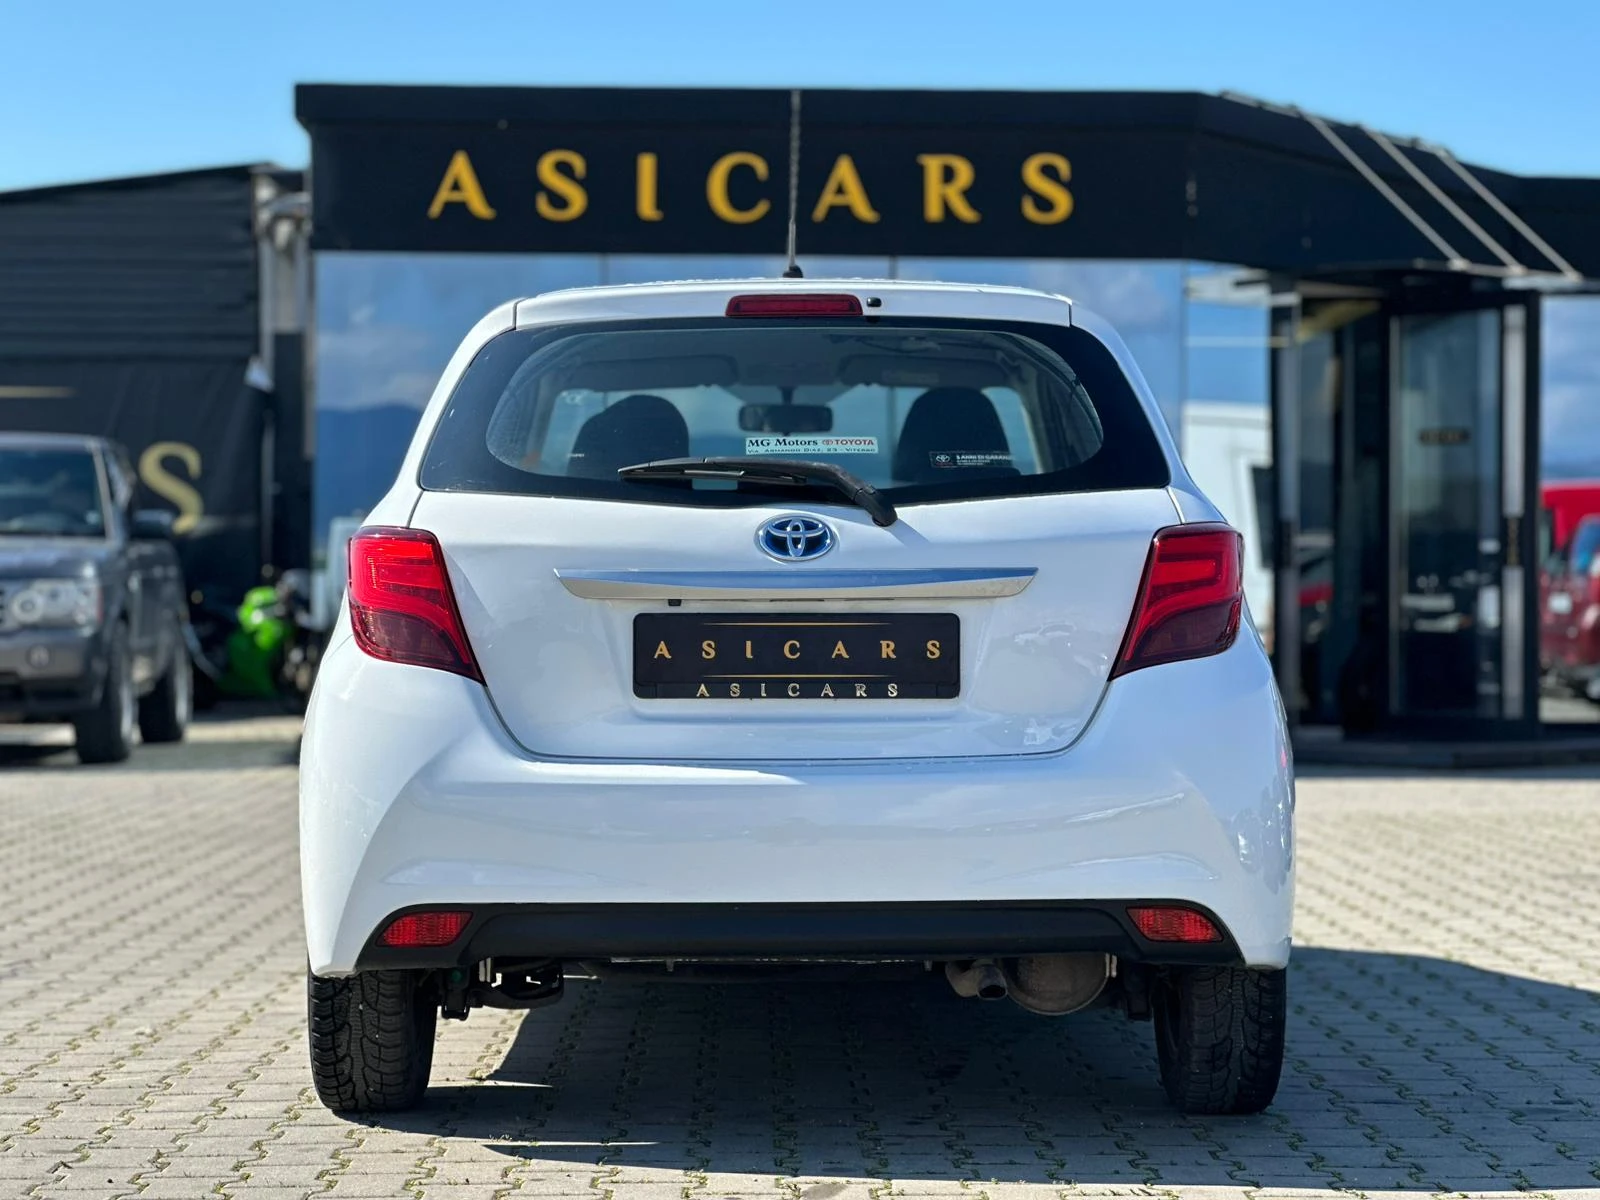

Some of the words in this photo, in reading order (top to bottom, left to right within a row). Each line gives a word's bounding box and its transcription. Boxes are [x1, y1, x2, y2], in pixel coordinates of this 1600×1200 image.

[427, 149, 1074, 224] ASICARS
[747, 439, 770, 447] MG
[774, 438, 818, 447] Motors
[653, 640, 941, 659] ASICARS
[696, 683, 898, 697] ASICARS
